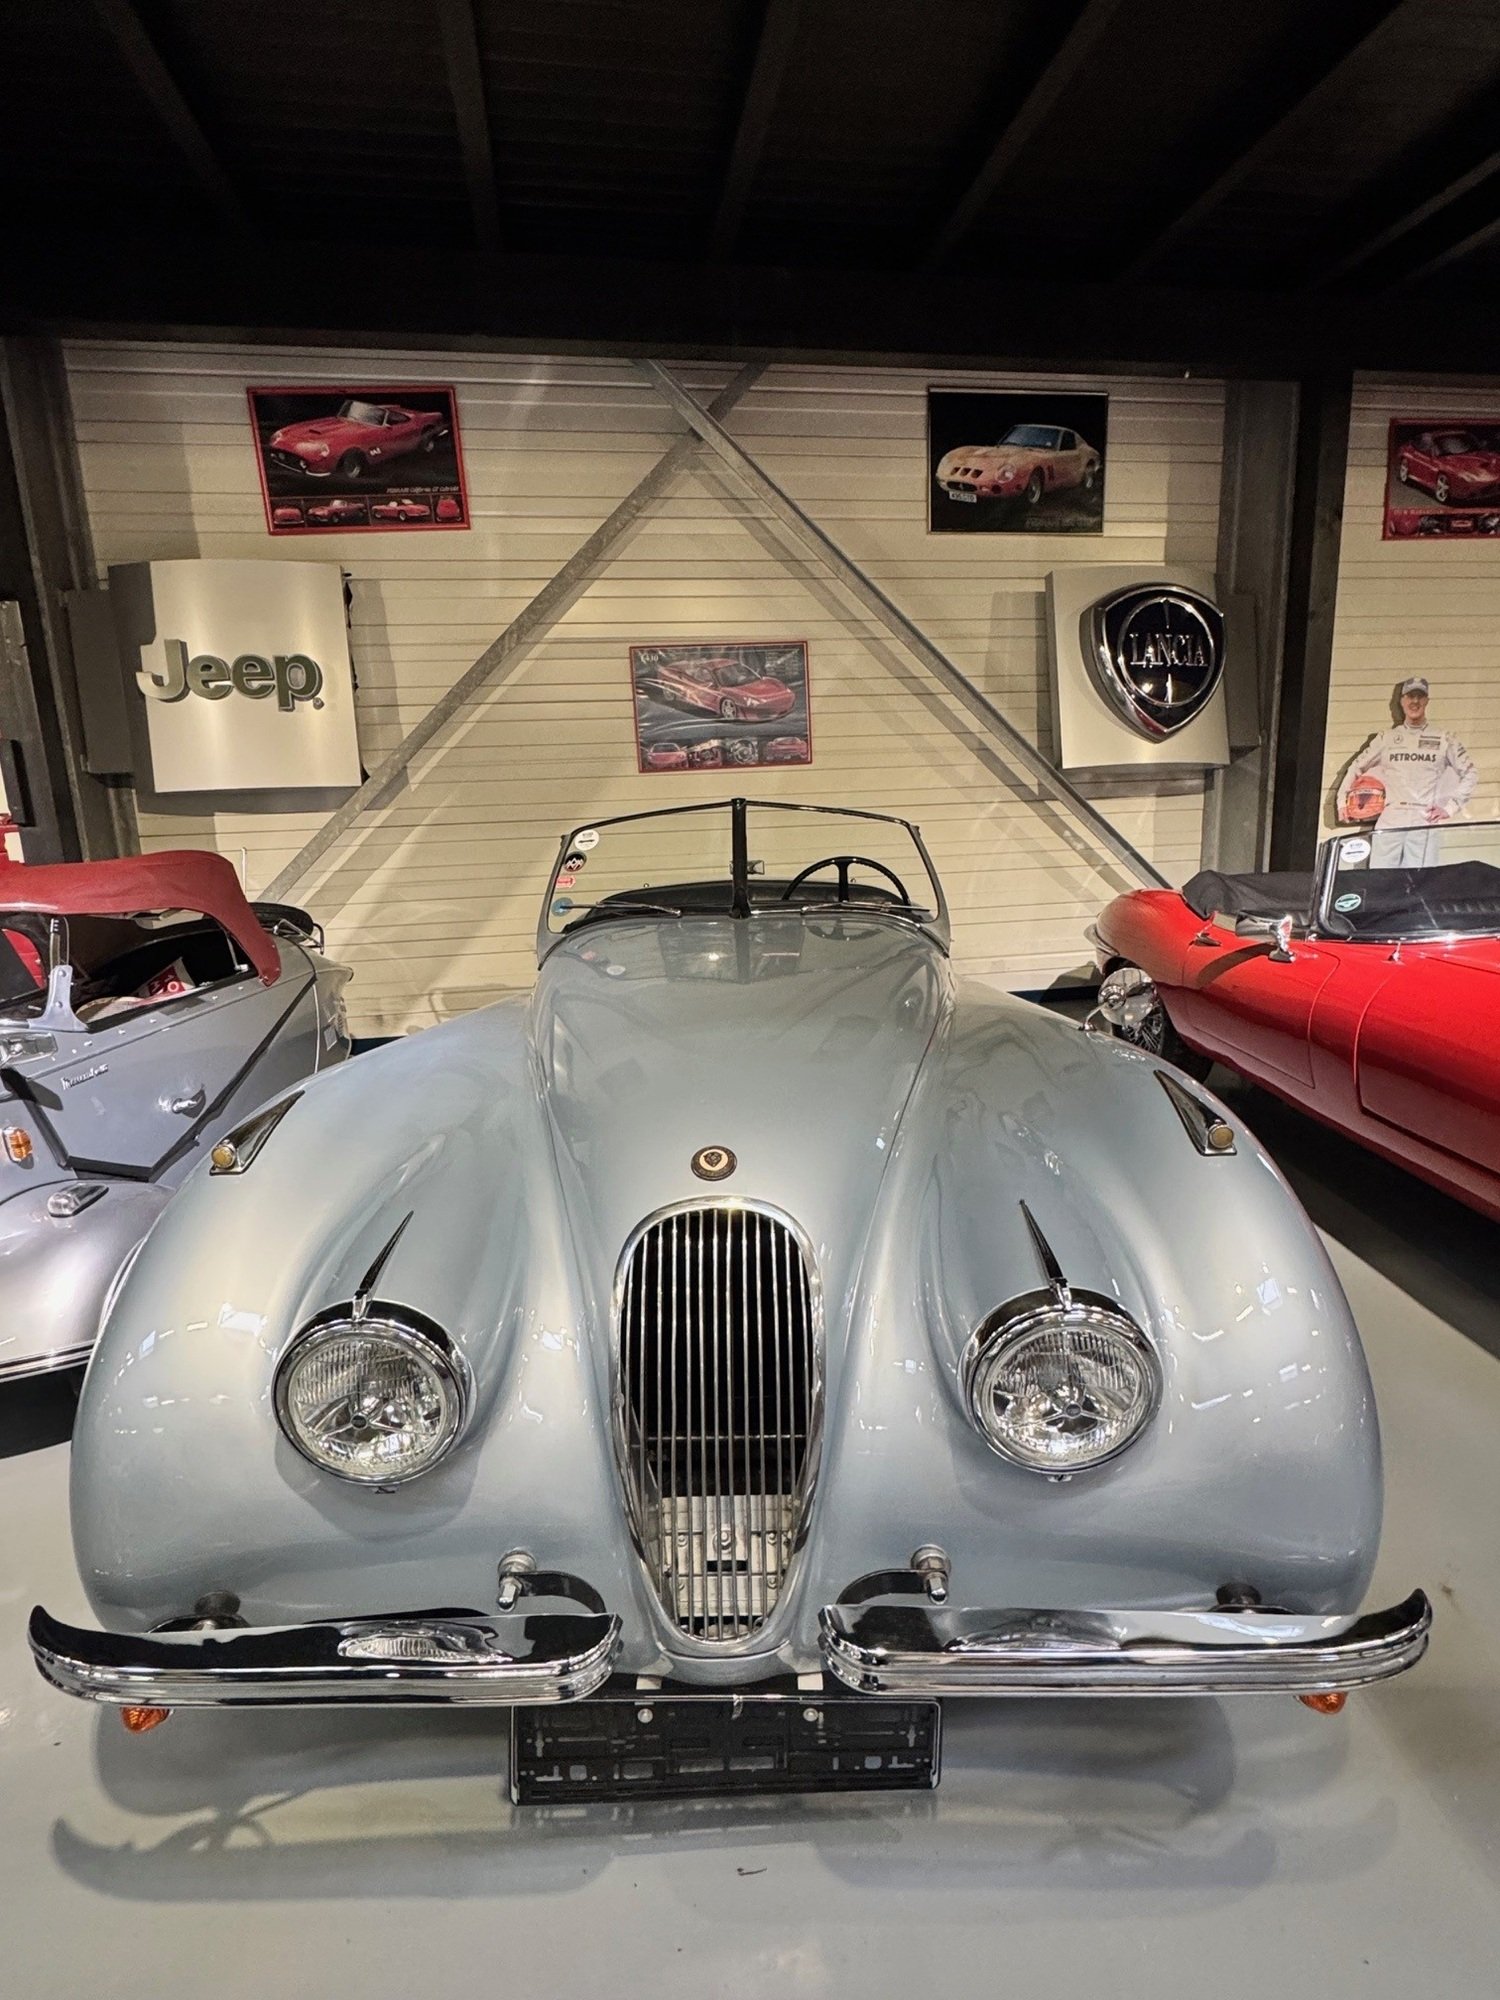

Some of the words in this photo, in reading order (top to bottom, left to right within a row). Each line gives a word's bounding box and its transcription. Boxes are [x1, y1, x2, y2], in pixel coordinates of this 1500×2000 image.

[1129, 632, 1208, 668] LANCIA
[136, 639, 323, 712] Jeep
[1389, 753, 1437, 763] PETRONAS
